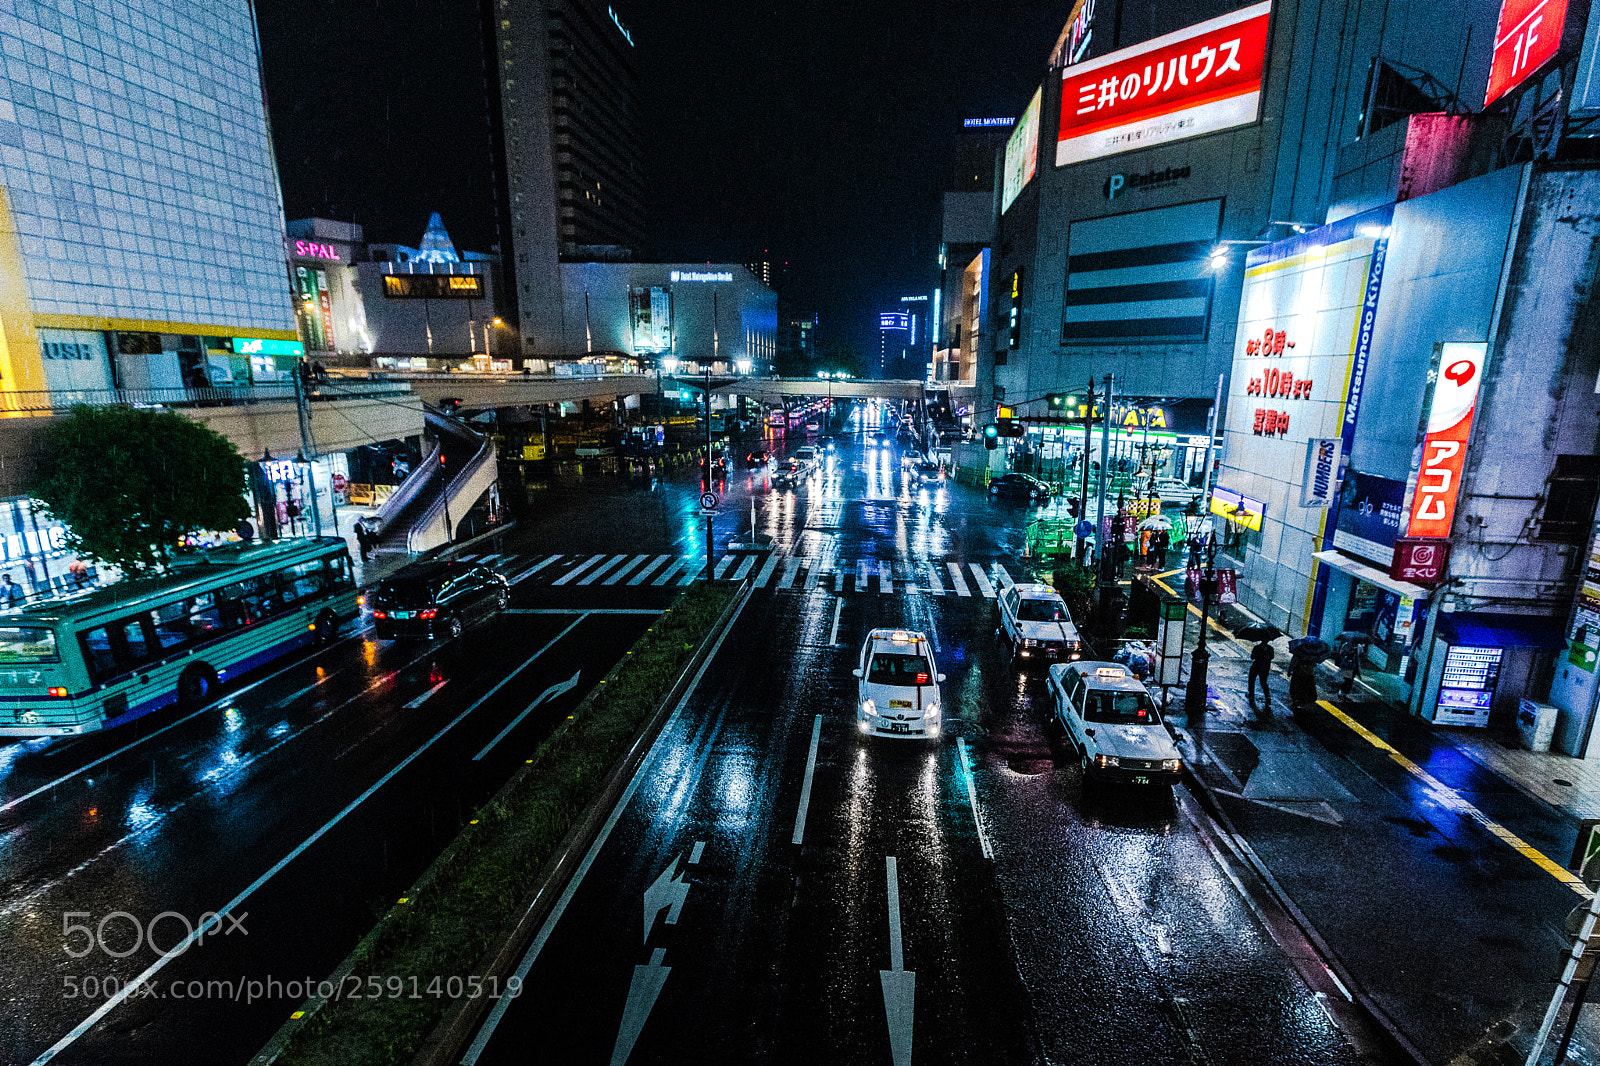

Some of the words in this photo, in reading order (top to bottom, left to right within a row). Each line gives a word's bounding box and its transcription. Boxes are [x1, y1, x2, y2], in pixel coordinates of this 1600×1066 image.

[1511, 14, 1543, 78] 1F
[1076, 37, 1241, 116] 三井のリハウス
[963, 118, 982, 127] HOTEL
[296, 240, 341, 261] S-PAL
[1346, 310, 1374, 425] Matsumoto
[1366, 238, 1388, 308] KiYosh
[1252, 408, 1290, 440] 営業中
[1313, 440, 1335, 499] NUMBERS
[1416, 440, 1460, 520] アコム
[1403, 567, 1437, 578] 宝くじ
